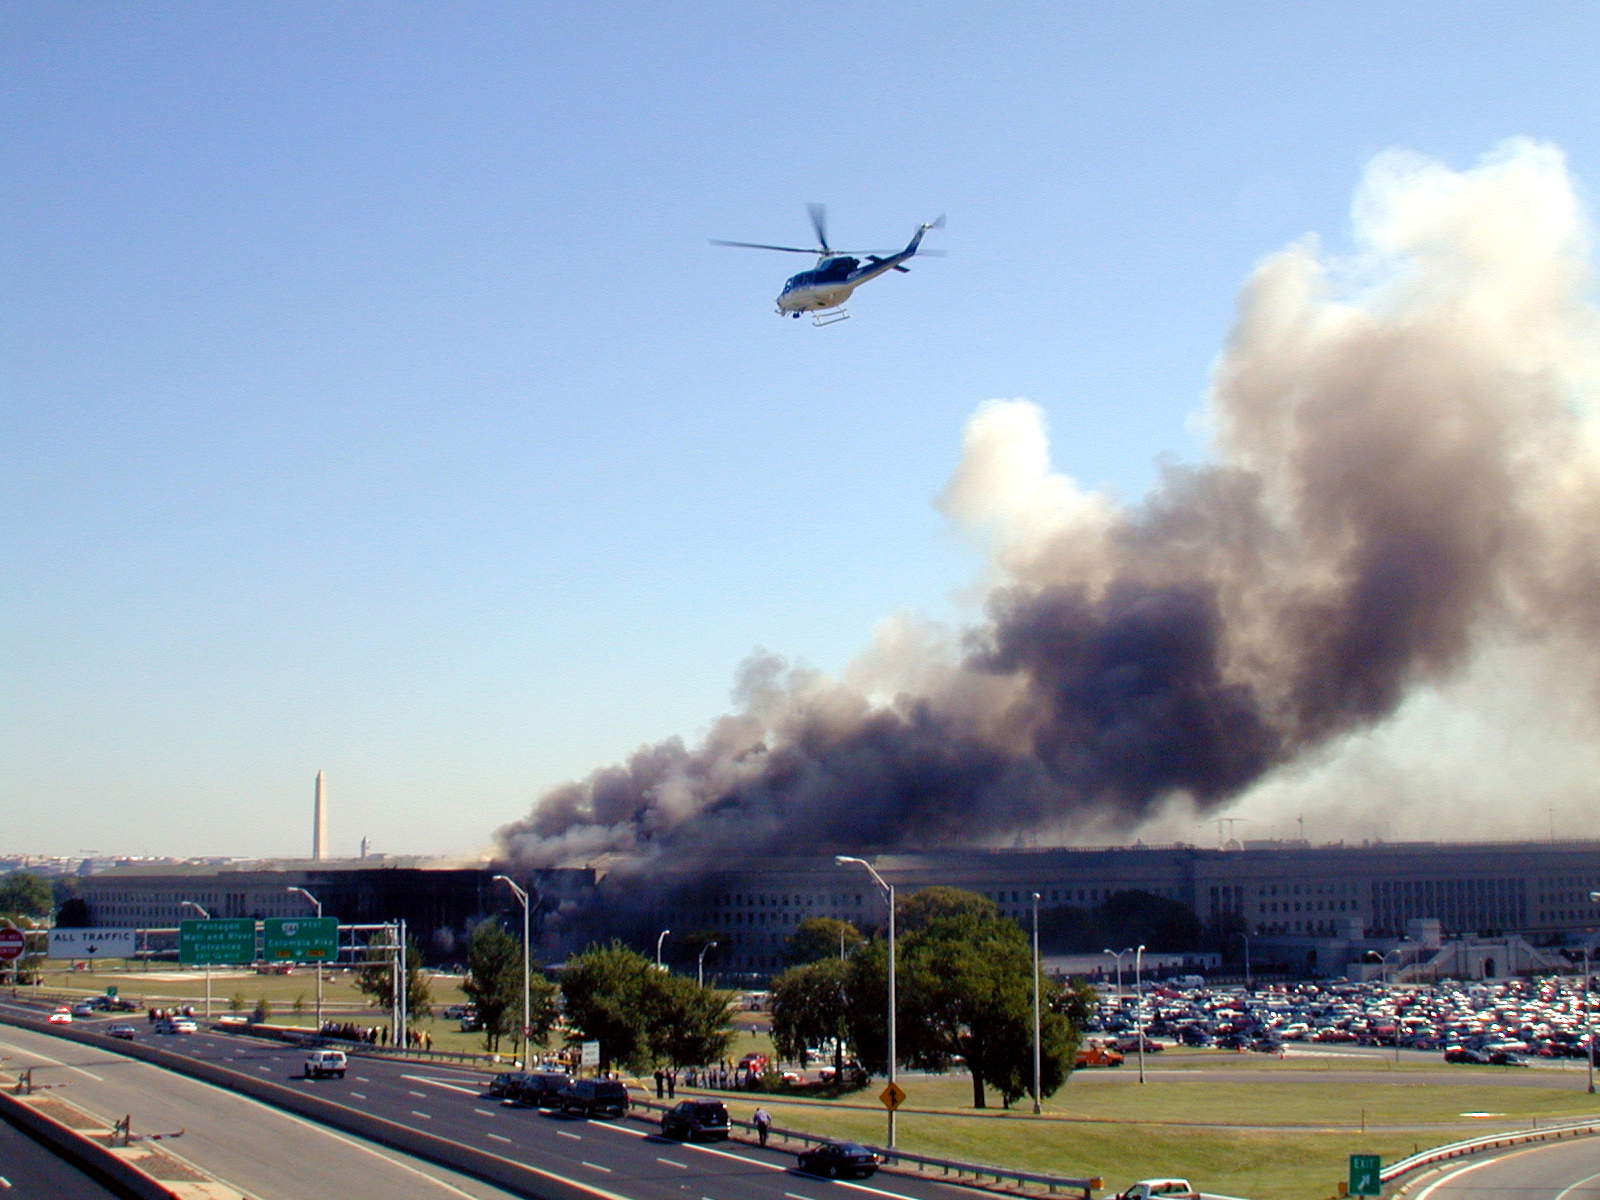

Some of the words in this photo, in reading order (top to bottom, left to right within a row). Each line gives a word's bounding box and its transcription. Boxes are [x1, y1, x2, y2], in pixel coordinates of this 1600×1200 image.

[196, 923, 240, 932] Pentagon
[54, 933, 76, 941] ALL
[82, 932, 130, 941] TRAFFIC
[183, 933, 204, 941] Mall
[207, 933, 224, 941] and
[228, 932, 252, 940] River
[194, 943, 241, 952] Entrances
[268, 939, 310, 948] Columbia
[315, 938, 334, 946] Pike
[1354, 1158, 1375, 1169] EXIT
